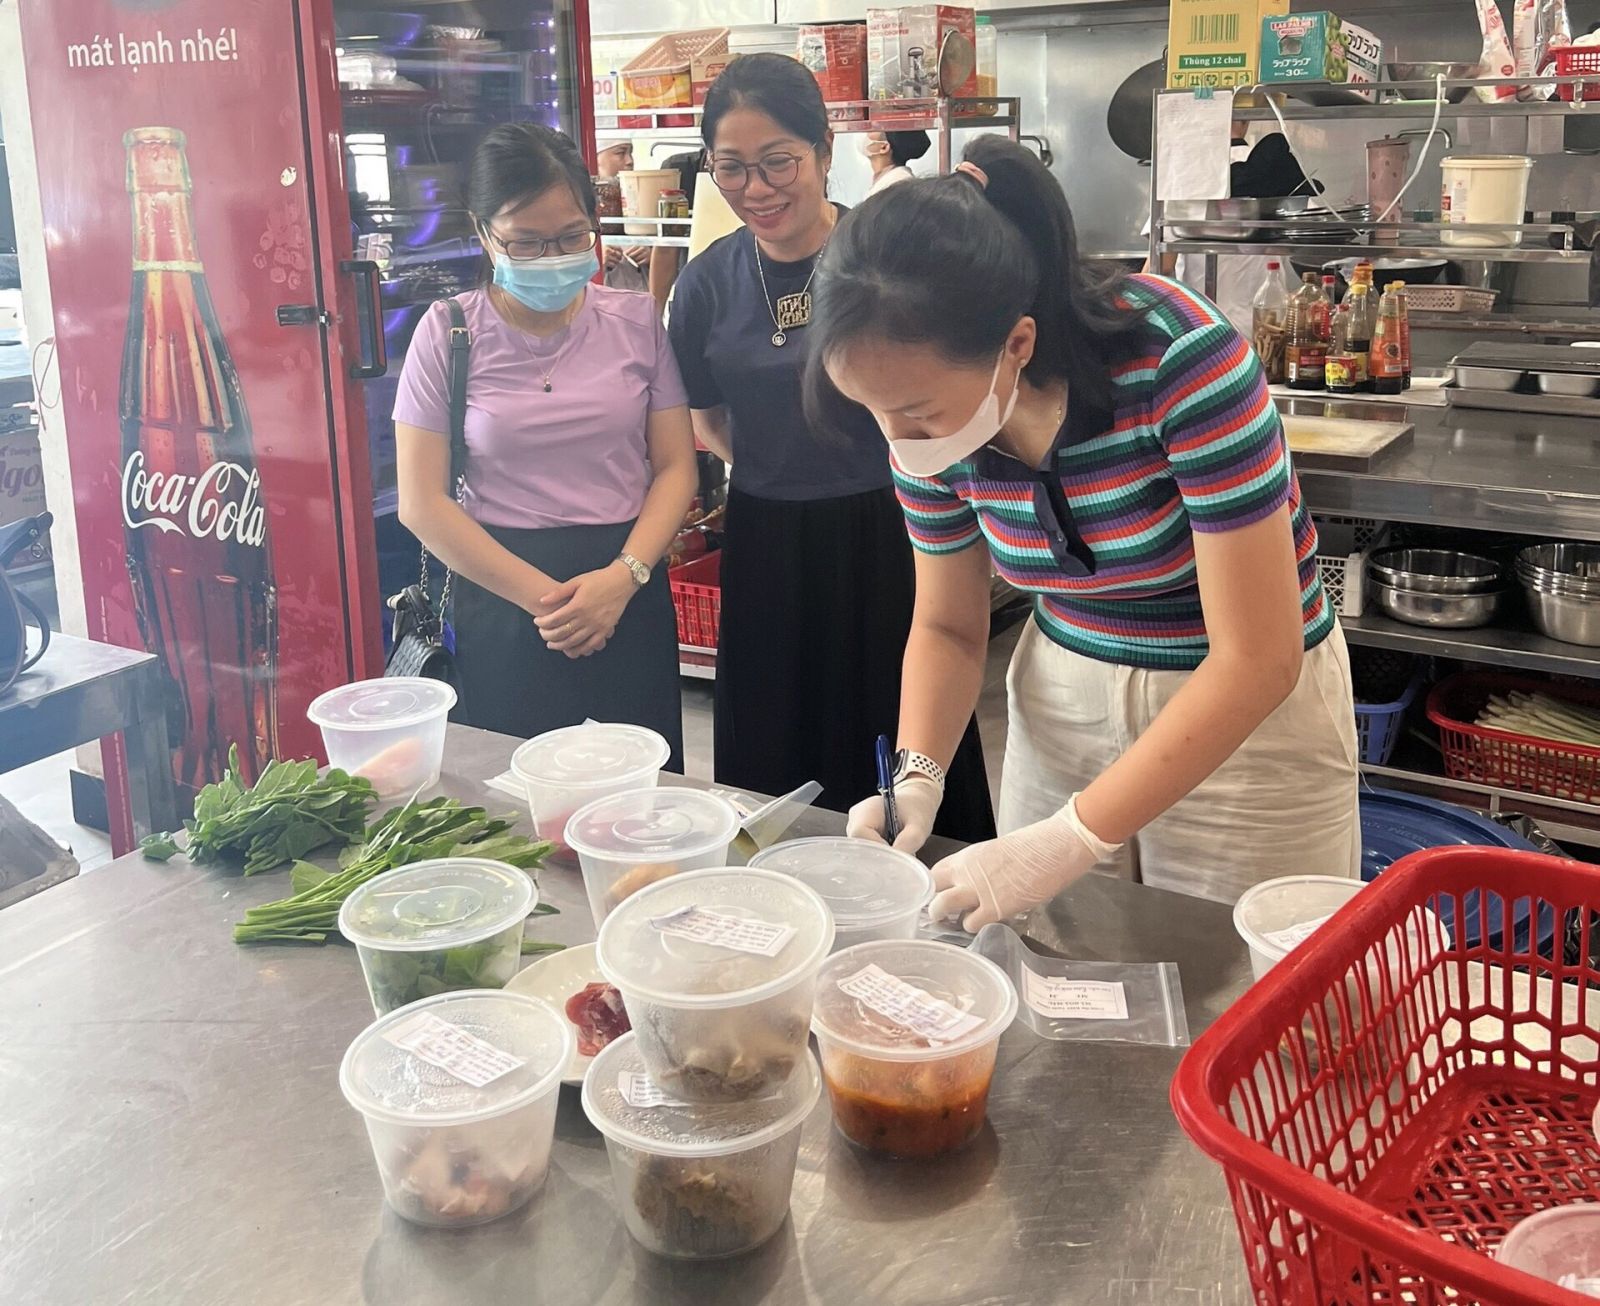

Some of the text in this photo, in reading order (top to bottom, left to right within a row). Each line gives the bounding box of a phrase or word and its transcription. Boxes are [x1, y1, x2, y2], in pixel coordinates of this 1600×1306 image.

[67, 27, 239, 73] mát lạnh nhé!
[1184, 55, 1242, 66] Thùng 12 chai
[1285, 68, 1301, 77] 30
[121, 450, 266, 547] Coca-Cola
